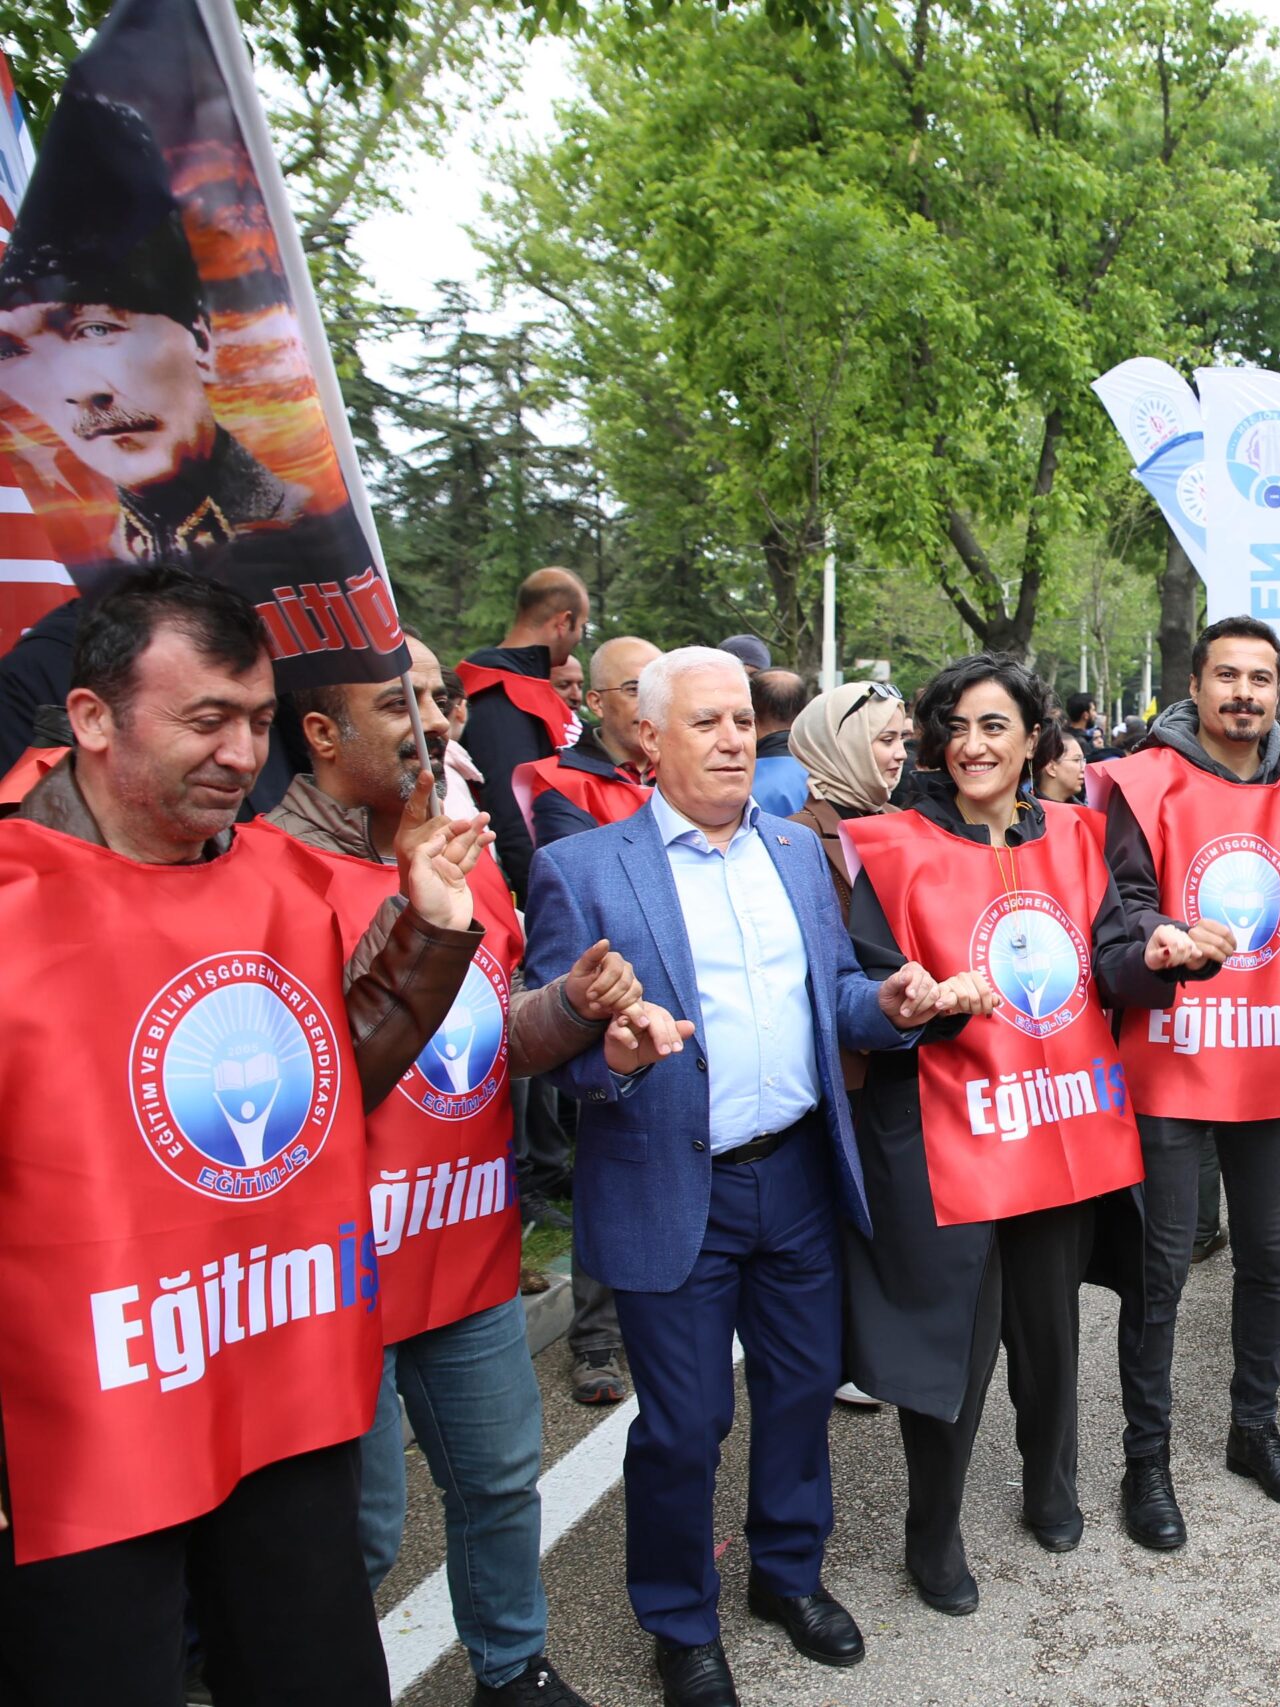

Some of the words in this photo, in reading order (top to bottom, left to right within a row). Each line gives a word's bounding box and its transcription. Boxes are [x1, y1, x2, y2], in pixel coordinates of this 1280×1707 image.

[1188, 875, 1199, 892] VE
[1195, 846, 1219, 873] BİLİM
[979, 909, 999, 943] BİLİM
[976, 943, 987, 962] VE
[1070, 929, 1089, 1000] SENDİKASI
[148, 983, 196, 1041] BİLİM
[195, 959, 309, 1013] İŞGÖRENLERİ
[140, 1046, 159, 1074] VE
[303, 1012, 334, 1126] SENDİKASI
[141, 1081, 184, 1159] EĞİTİM
[422, 1077, 498, 1116] EĞİTİM-İŞ
[197, 1143, 311, 1195] EĞİTİM-İŞ
